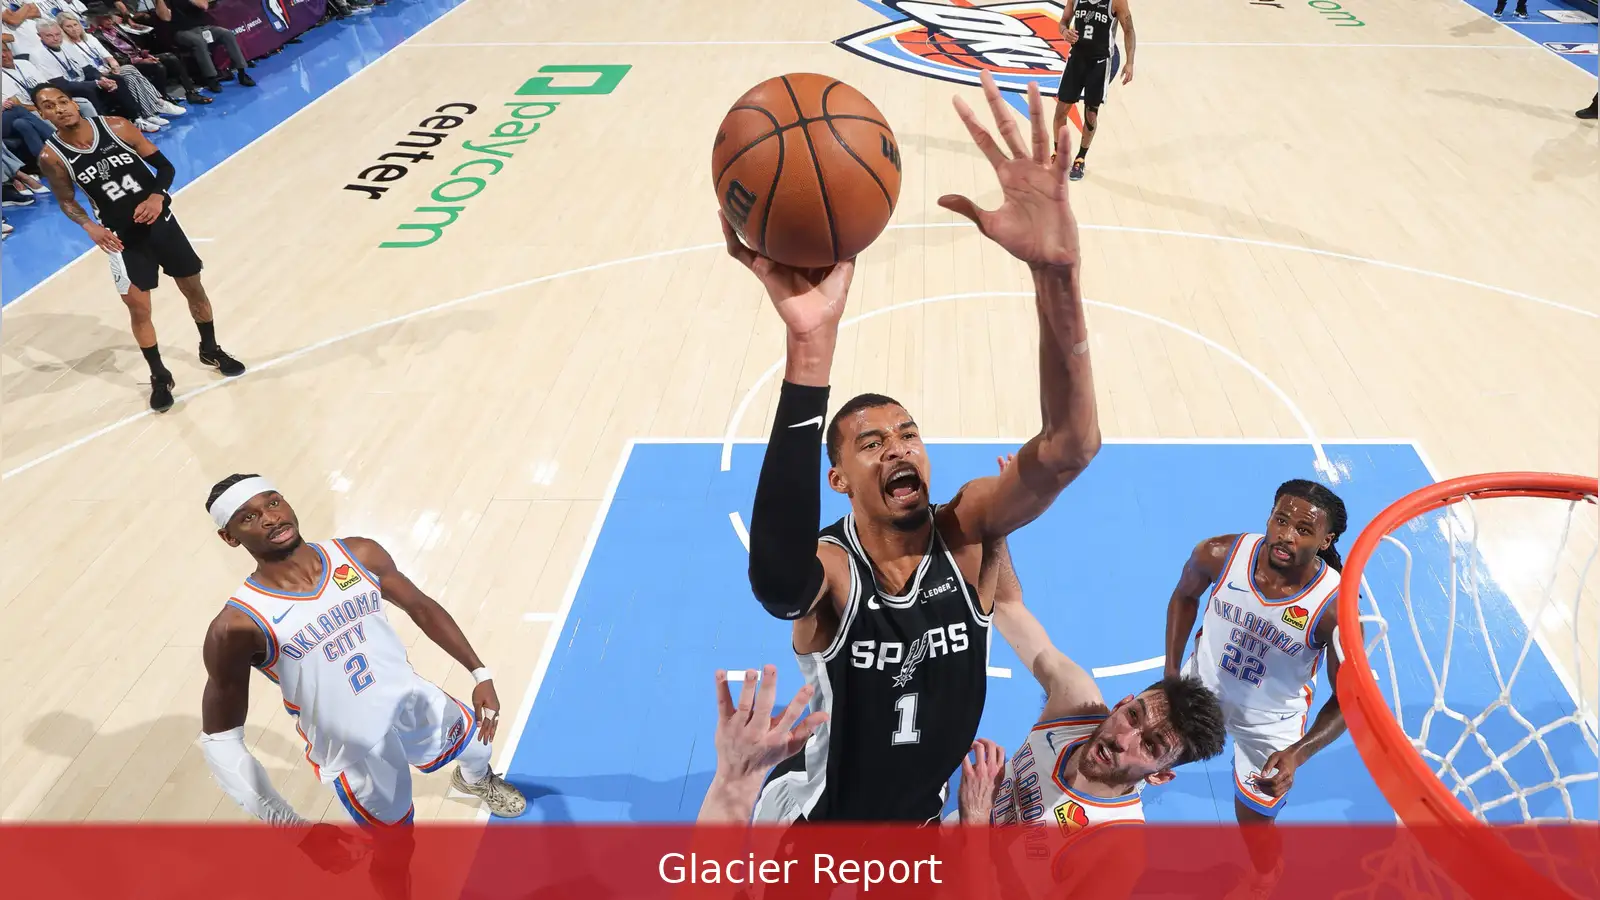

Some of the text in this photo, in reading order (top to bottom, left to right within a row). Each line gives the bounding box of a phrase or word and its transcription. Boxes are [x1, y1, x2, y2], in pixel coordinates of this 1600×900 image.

[1075, 10, 1108, 23] SPURS
[1083, 25, 1094, 40] 2
[77, 152, 134, 184] SPURS
[343, 102, 478, 200] center
[101, 174, 143, 202] 24
[378, 101, 561, 248] paycom
[923, 583, 951, 599] LEDGER
[280, 590, 382, 661] OKLAHOMA
[322, 621, 367, 662] CITY
[1213, 596, 1305, 657] OKLAHOMA
[1229, 626, 1271, 658] CITY
[344, 652, 376, 696] 2
[851, 621, 970, 688] SPURS
[1218, 642, 1268, 689] 22
[891, 692, 921, 746] 1
[1012, 742, 1050, 860] KLAHOMA
